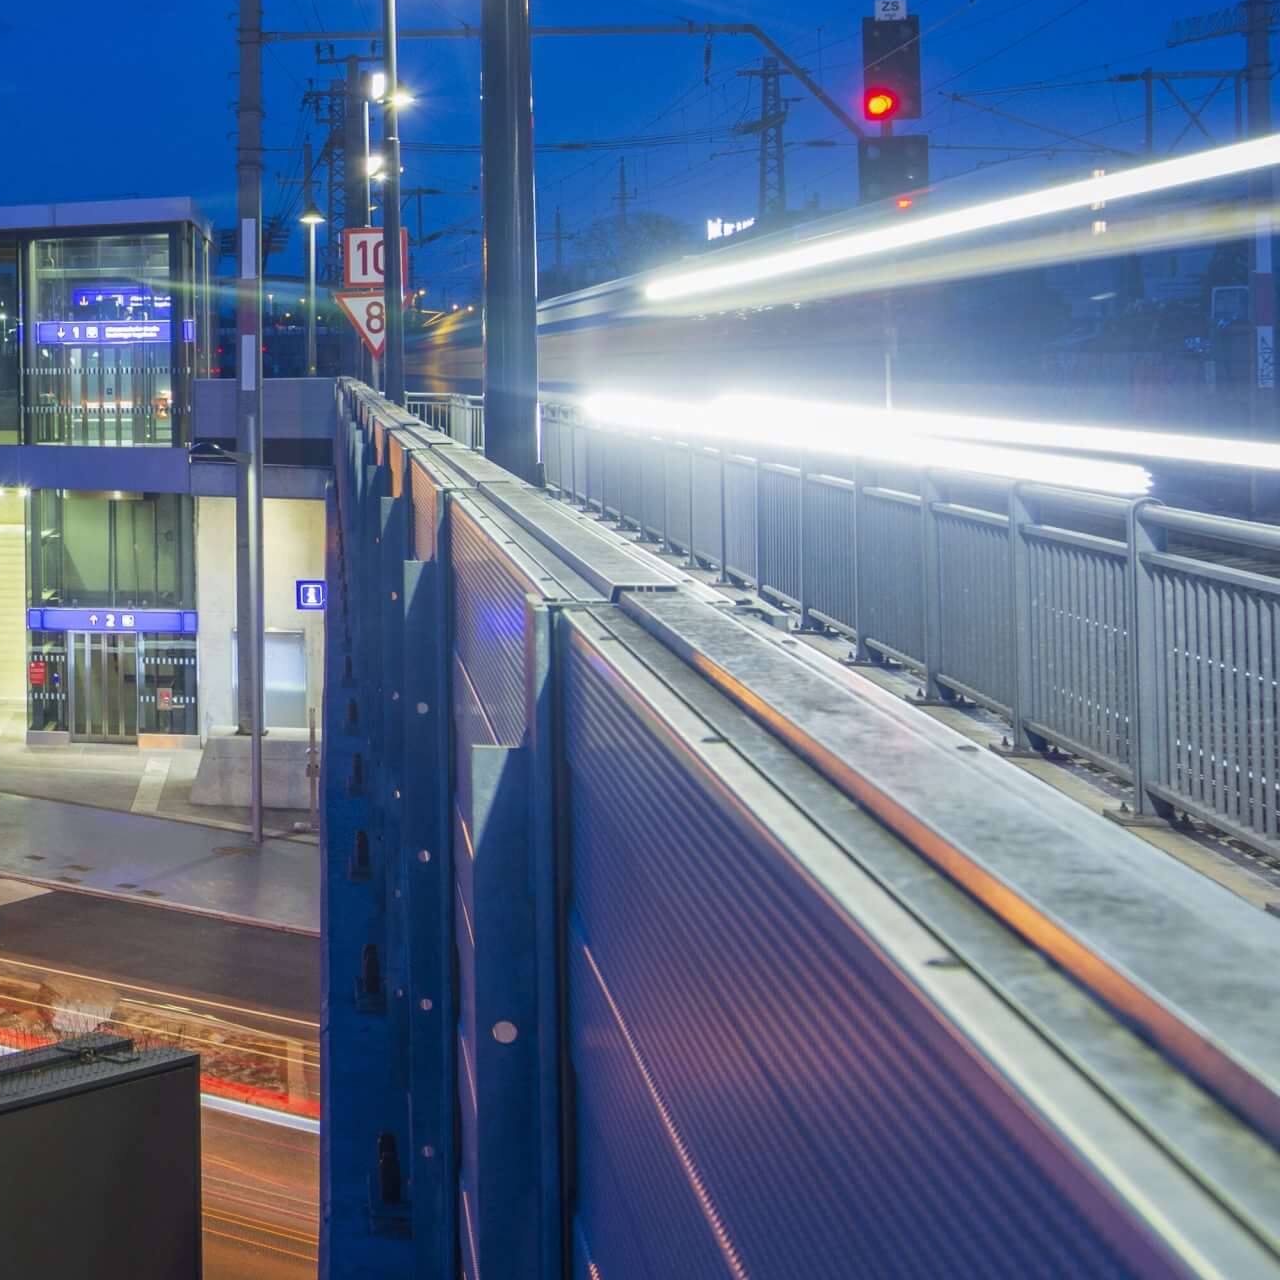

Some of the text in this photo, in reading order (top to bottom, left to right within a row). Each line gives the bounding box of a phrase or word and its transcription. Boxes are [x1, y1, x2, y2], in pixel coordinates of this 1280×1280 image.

[366, 301, 385, 334] 8
[72, 326, 80, 339] 1
[105, 614, 116, 627] 2
